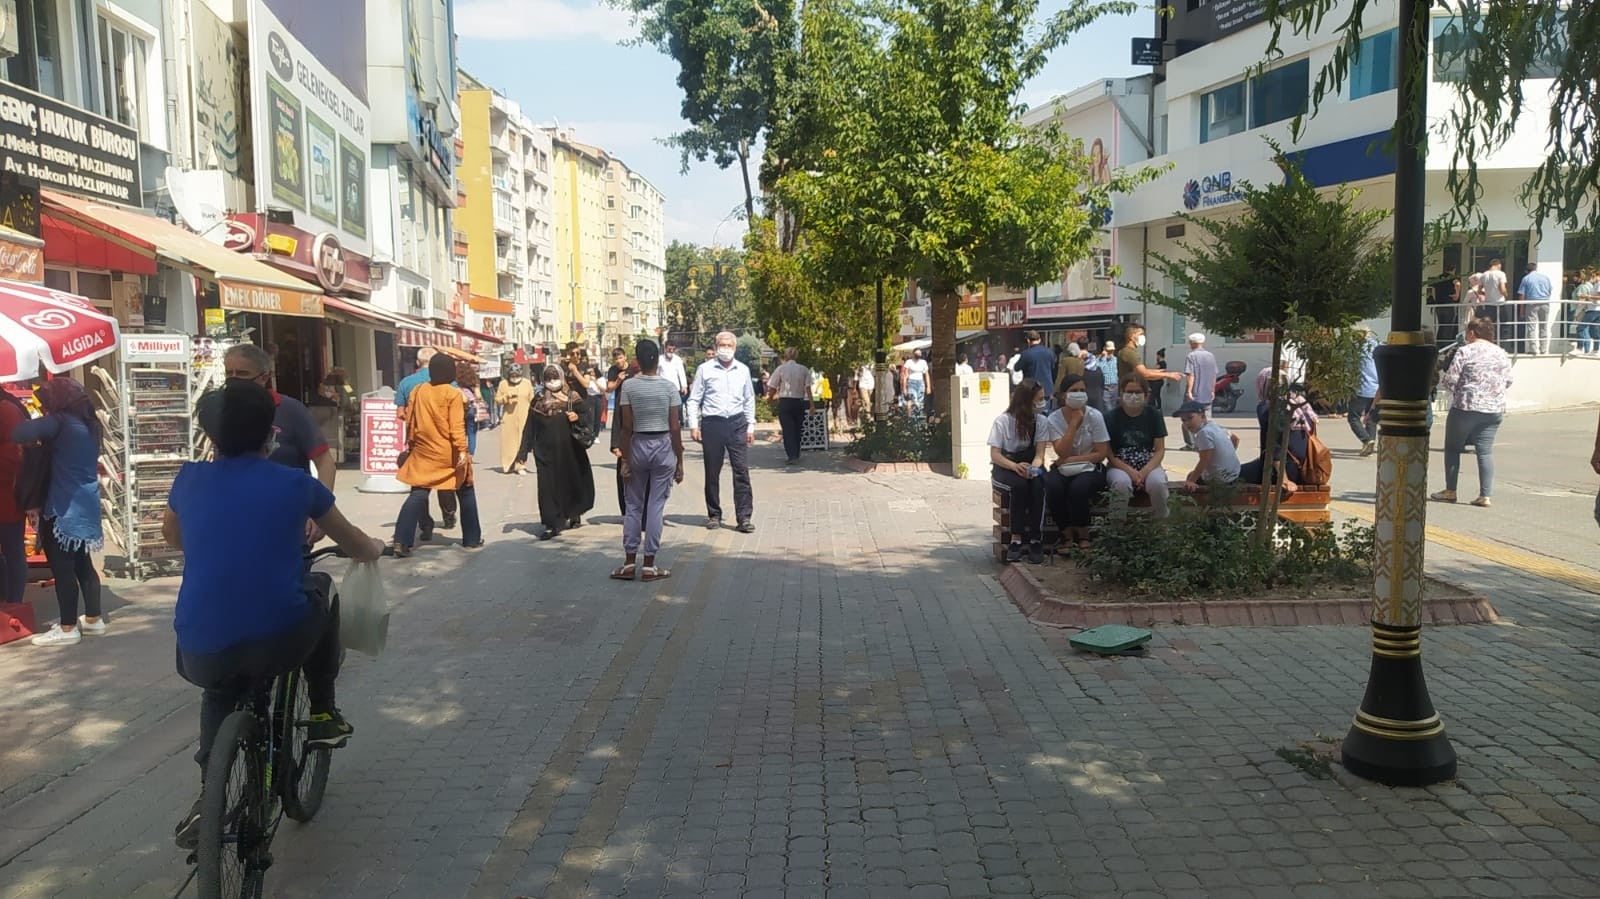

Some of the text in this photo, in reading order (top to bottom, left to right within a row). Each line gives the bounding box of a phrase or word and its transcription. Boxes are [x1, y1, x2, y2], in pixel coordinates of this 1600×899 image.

[297, 60, 341, 118] GELENEKSEL
[341, 100, 365, 138] TATLAR
[39, 107, 88, 145] HUKUK
[90, 124, 136, 160] BÜROSU
[5, 157, 129, 200] Av. Hakan NAZLIPINAR
[40, 143, 79, 172] ERGENÇ
[80, 155, 134, 183] NAZLIPINAR
[1202, 171, 1231, 193] QNB
[224, 285, 250, 307] EMEK
[251, 287, 281, 310] DÖNER
[138, 341, 180, 352] Milliyet
